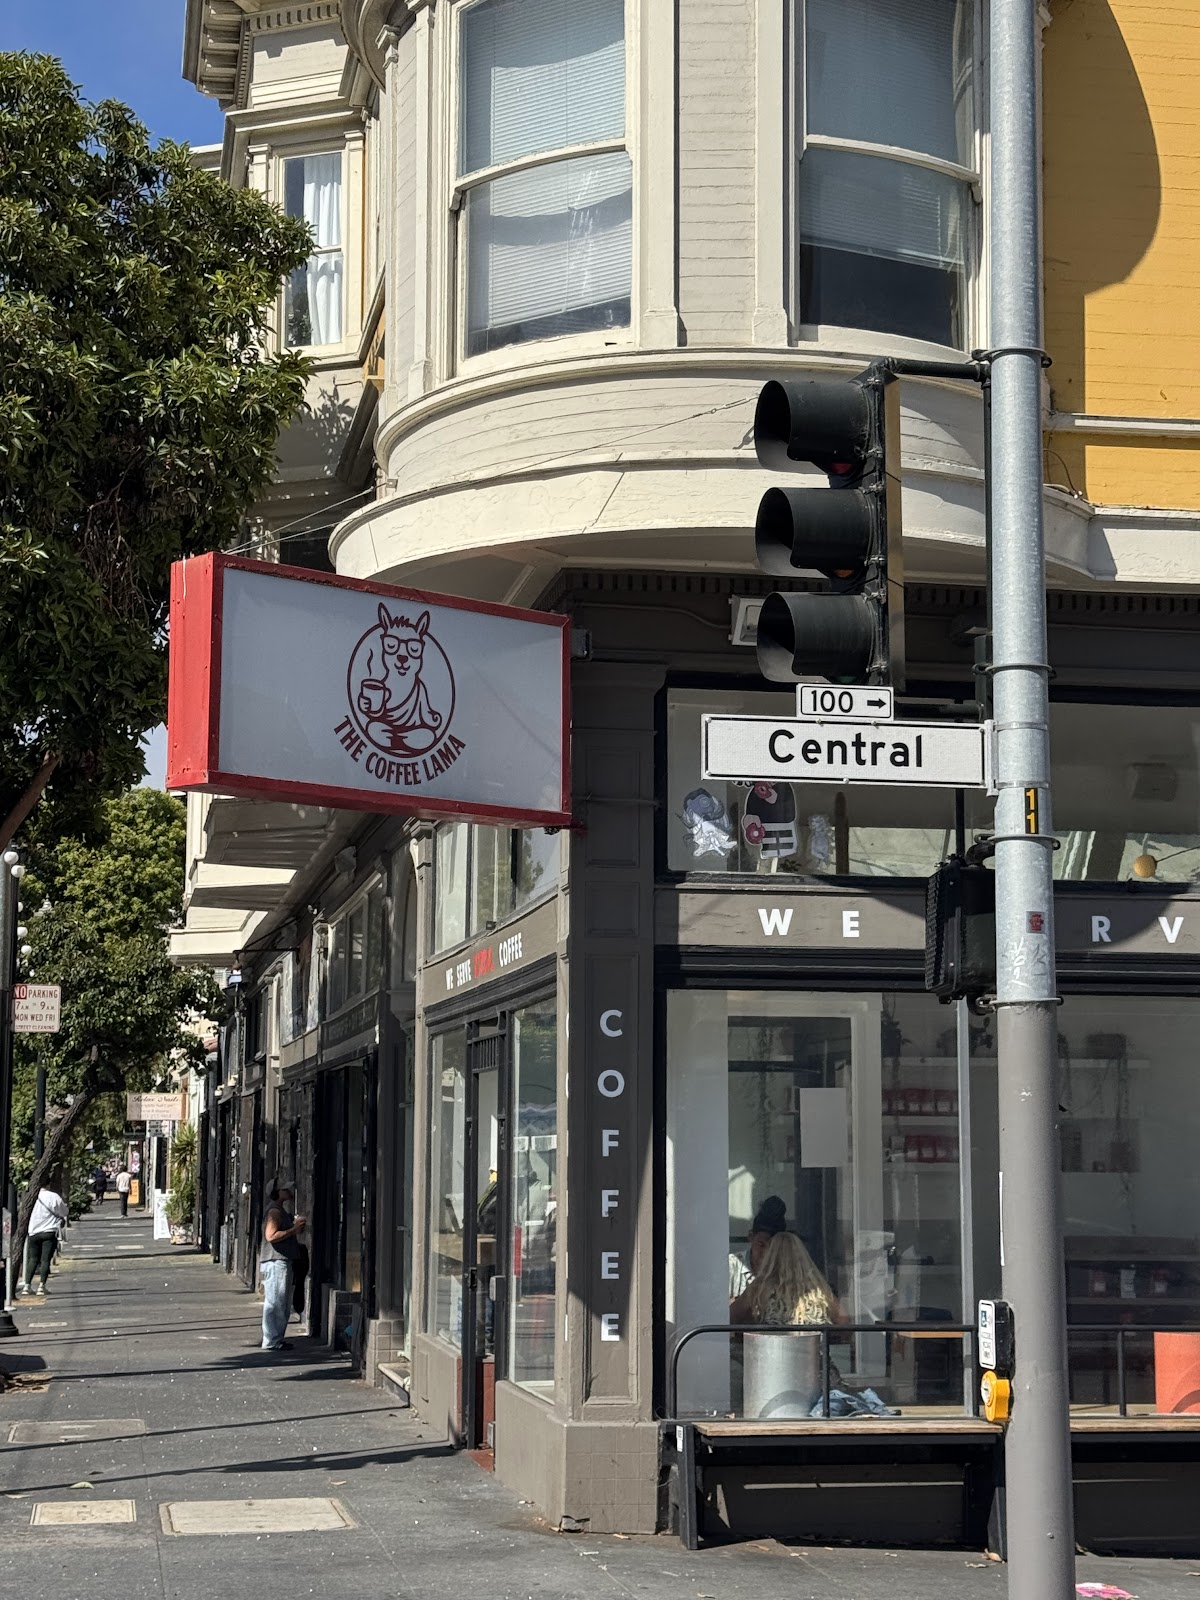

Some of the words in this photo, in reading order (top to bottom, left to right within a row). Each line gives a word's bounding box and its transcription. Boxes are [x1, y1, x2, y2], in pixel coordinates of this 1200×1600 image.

[810, 689, 854, 714] 100
[333, 715, 368, 763] THE
[365, 751, 422, 786] COFFEE
[421, 733, 467, 782] LAMA
[768, 729, 923, 768] Central
[445, 967, 454, 991] WE
[456, 958, 472, 987] SERVE
[498, 932, 523, 968] COFFEE
[14, 986, 27, 998] NO
[28, 990, 58, 998] PARKING
[15, 1013, 29, 1022] MON
[30, 1013, 44, 1022] WED
[45, 1013, 56, 1022] FRI
[597, 1009, 626, 1342] COFFEE
